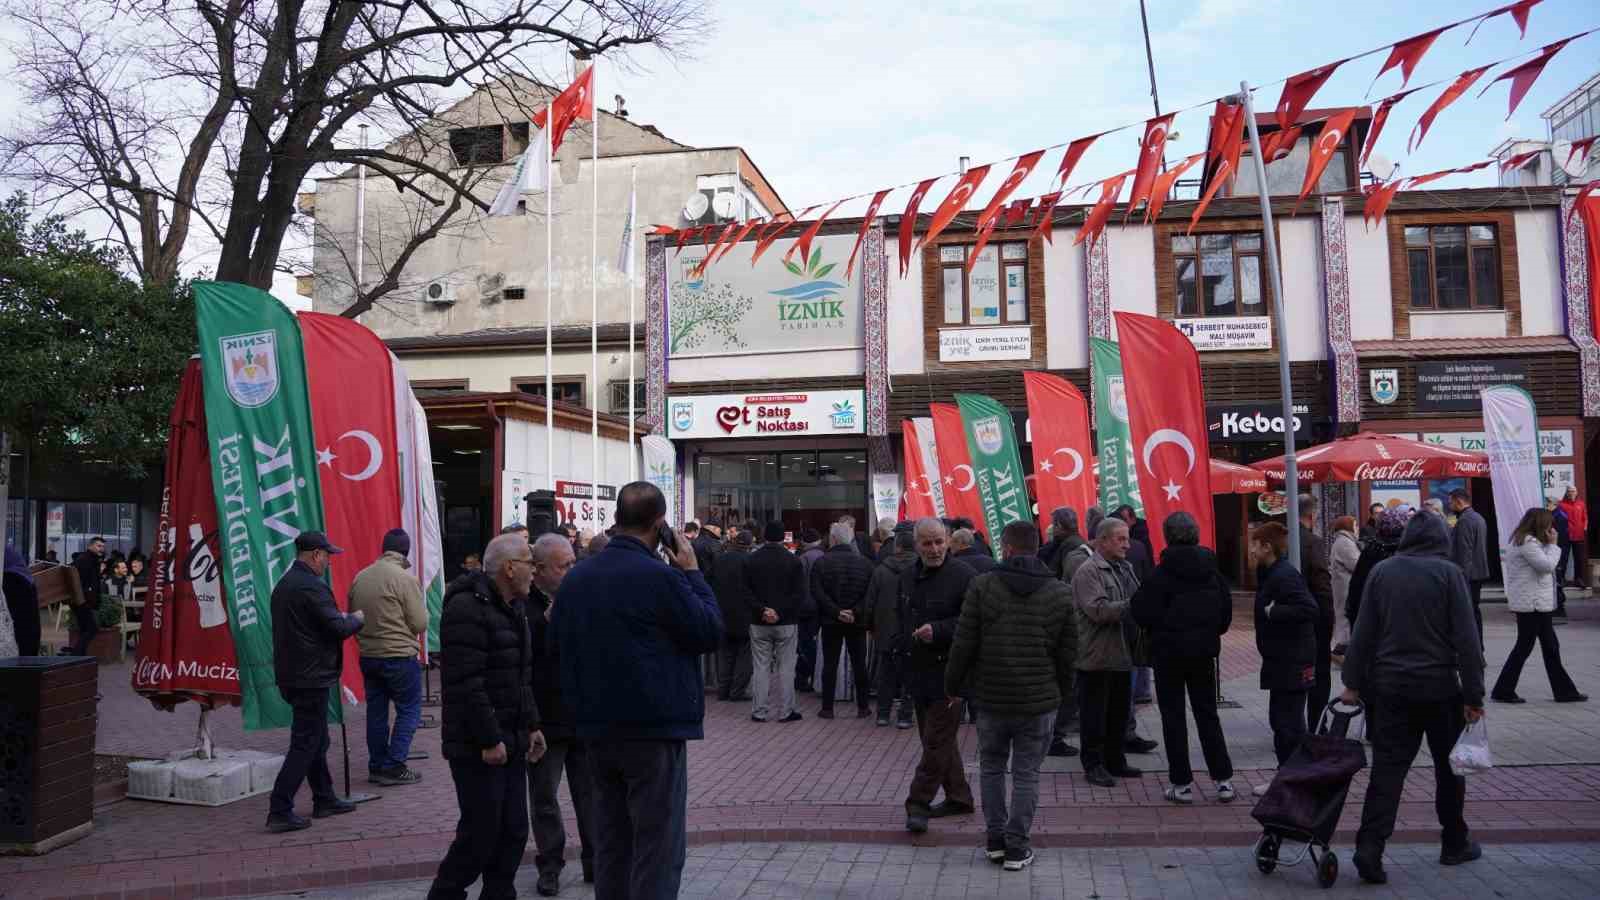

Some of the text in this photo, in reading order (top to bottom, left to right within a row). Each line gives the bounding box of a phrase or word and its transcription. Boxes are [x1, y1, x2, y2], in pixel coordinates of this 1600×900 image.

[778, 298, 844, 320] İZNİK
[1196, 323, 1224, 331] SERBEST
[757, 406, 791, 419] Satış
[757, 420, 809, 433] Noktası
[1461, 436, 1485, 450] İZN
[581, 501, 606, 526] Saış
